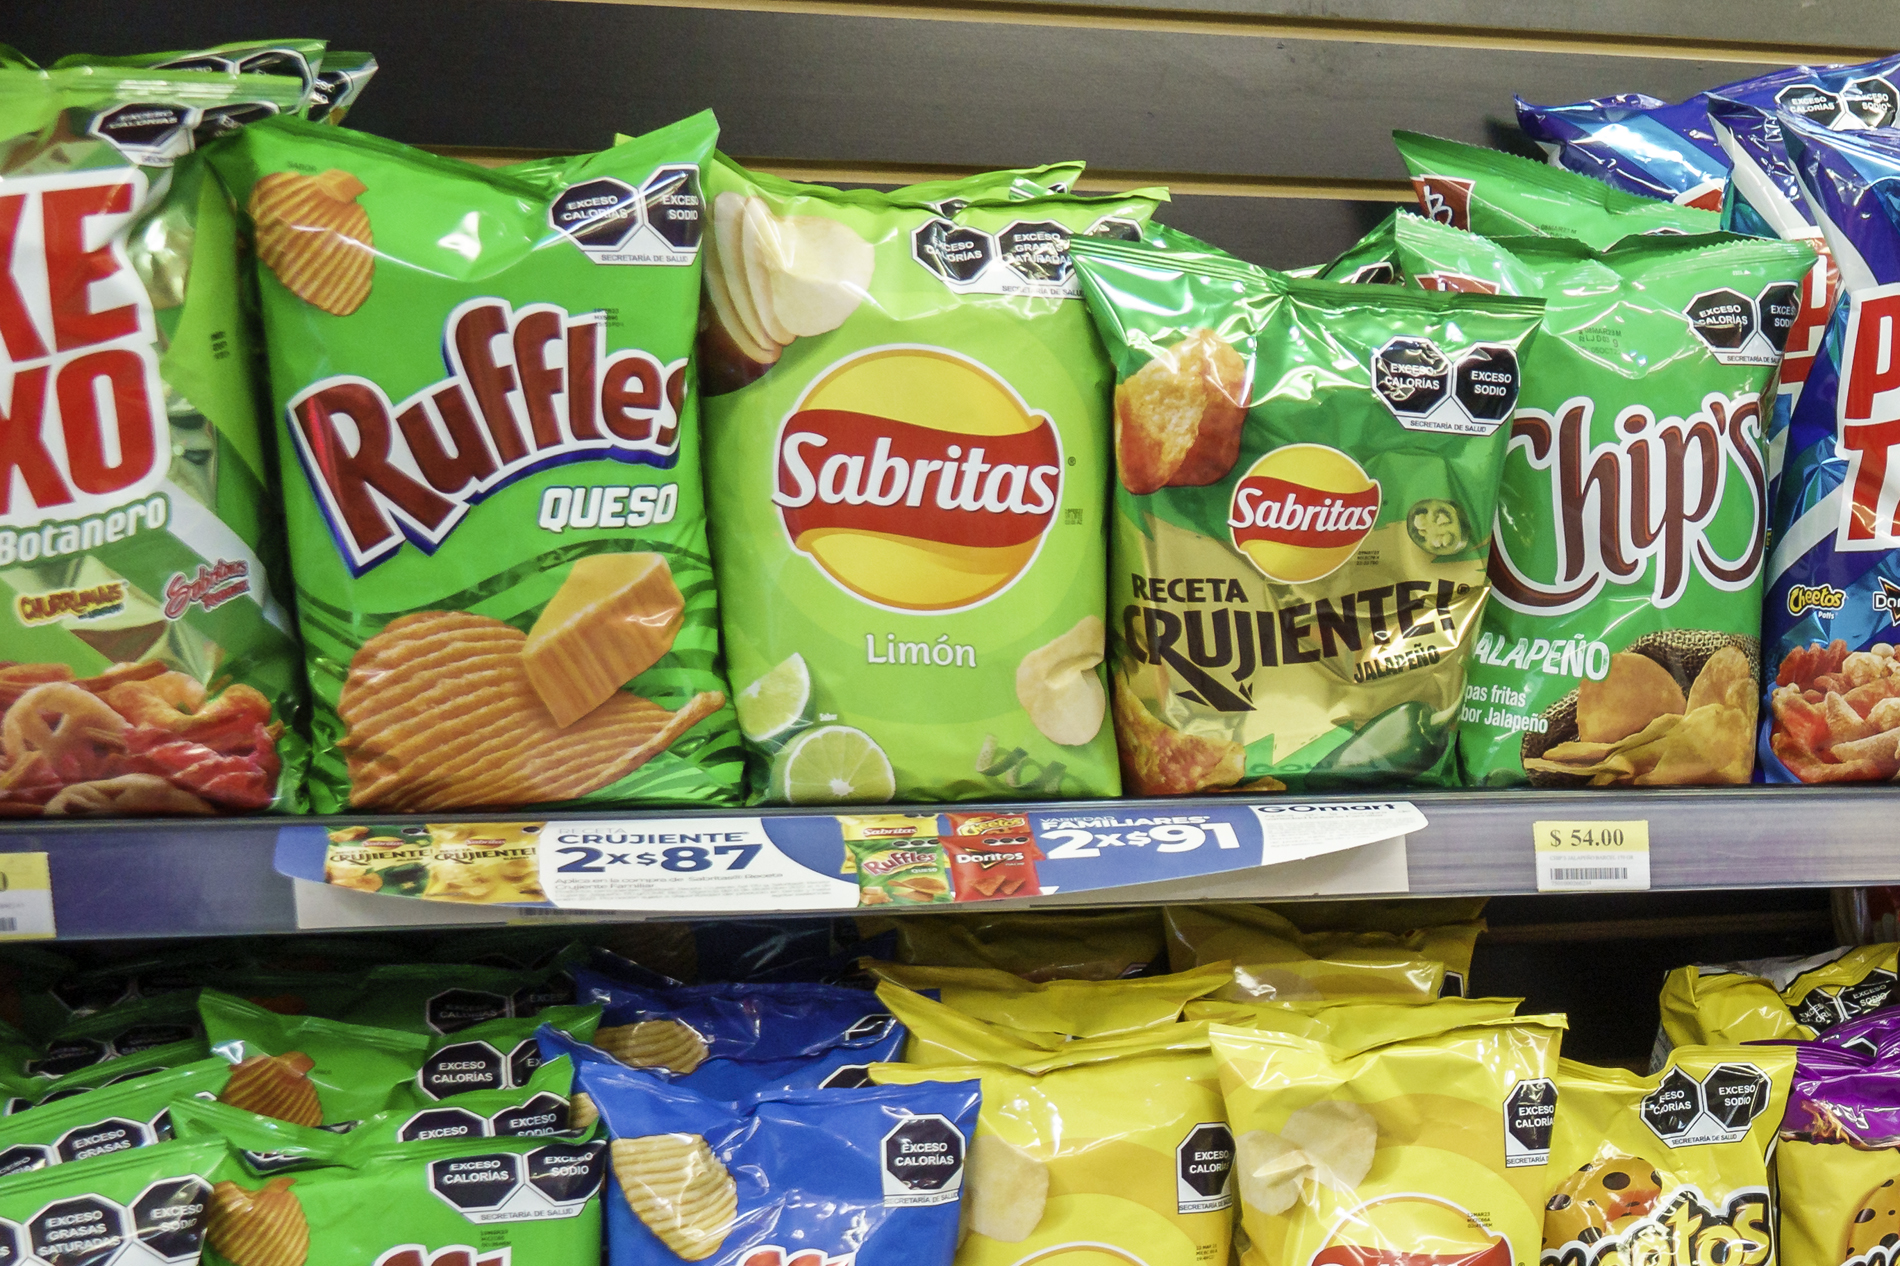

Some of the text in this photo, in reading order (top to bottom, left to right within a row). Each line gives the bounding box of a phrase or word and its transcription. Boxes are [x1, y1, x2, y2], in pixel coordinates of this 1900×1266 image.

[295, 302, 692, 562] Ruffles
[1410, 419, 1451, 431] SECRETARÍA
[1453, 422, 1463, 432] DE
[775, 432, 1061, 517] Sabritas
[540, 484, 679, 534] QUESO
[1229, 488, 1377, 534] Sabritas
[1133, 574, 1249, 604] RECETA
[1788, 584, 1845, 615] Cheetos
[866, 633, 977, 669] Limón
[1047, 822, 1240, 860] 2x$91
[1550, 829, 1624, 848] $ 54.00
[555, 844, 763, 873] 2x$87
[896, 1152, 954, 1167] CALORÍAS
[901, 1142, 948, 1155] EXCESO
